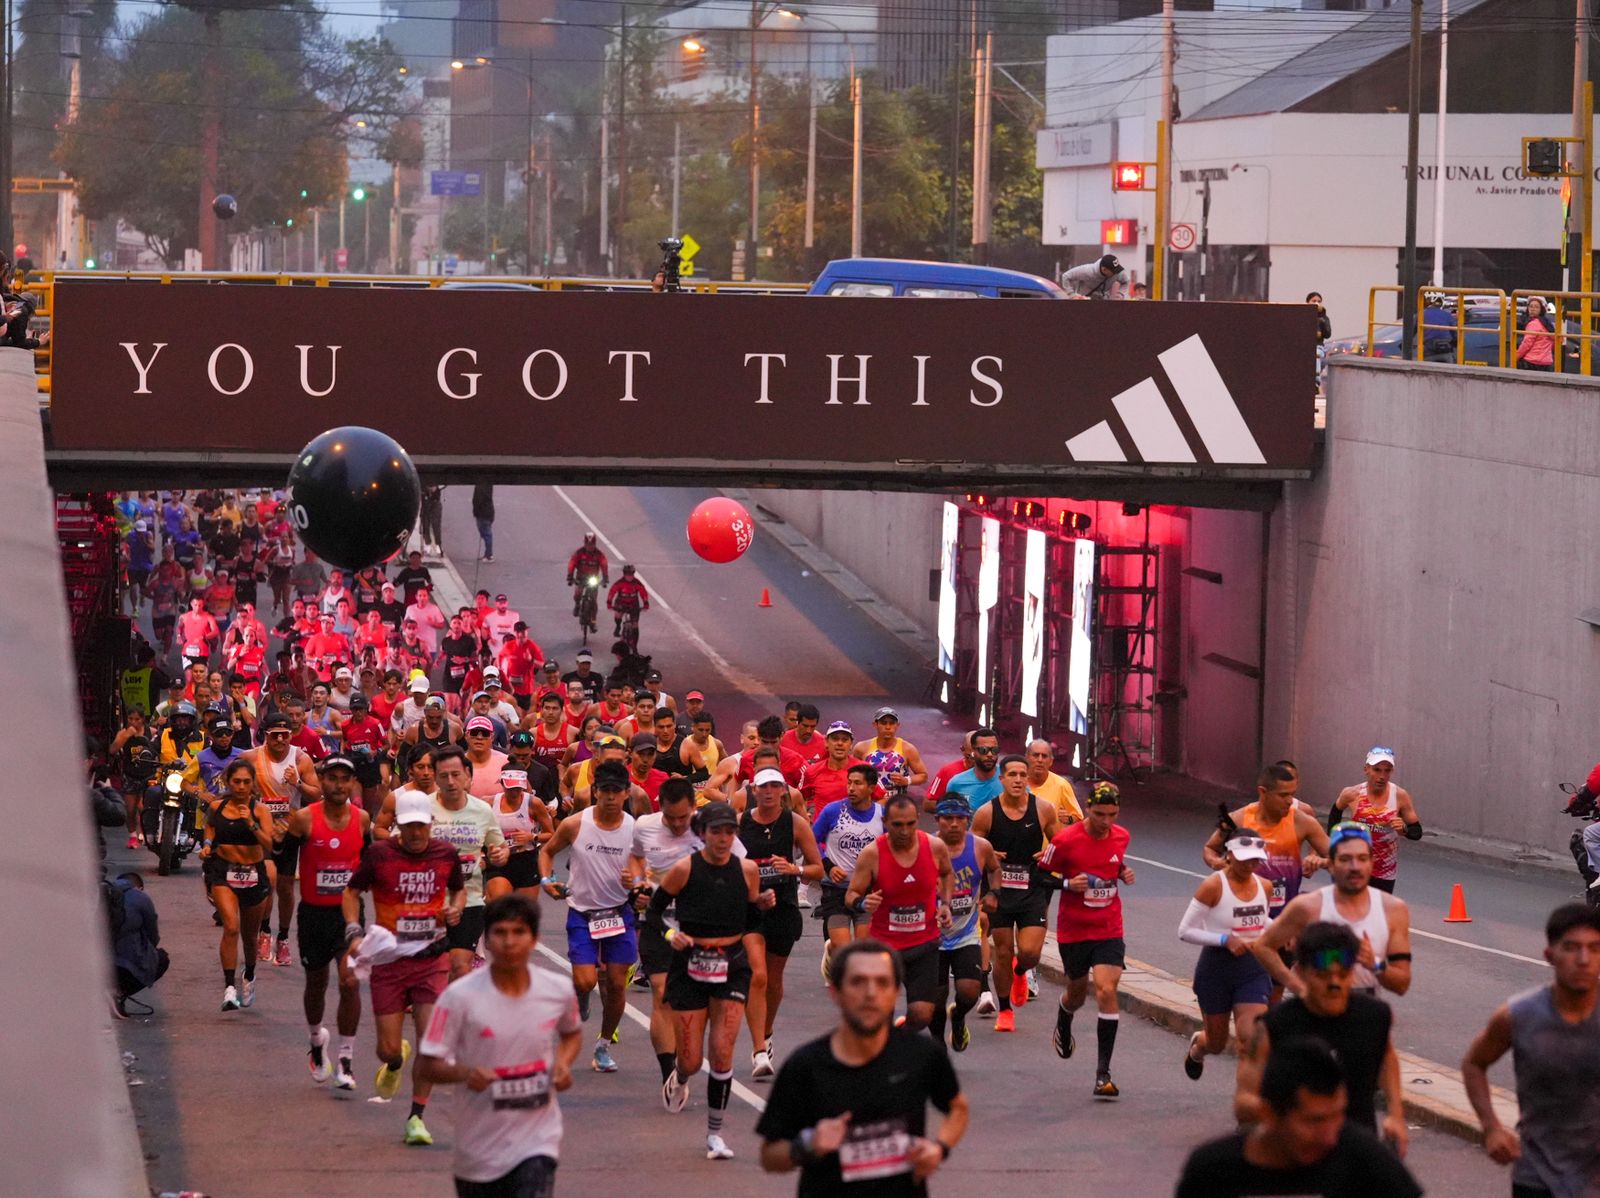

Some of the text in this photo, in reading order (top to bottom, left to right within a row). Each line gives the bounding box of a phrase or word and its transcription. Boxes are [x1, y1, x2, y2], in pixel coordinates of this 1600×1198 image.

[1475, 186, 1488, 194] Av.
[1490, 186, 1517, 195] Javier
[1520, 187, 1546, 195] Prado
[1175, 229, 1190, 242] 30
[119, 342, 1004, 407] YOU GOT THIS
[731, 519, 748, 553] 3:20
[233, 872, 251, 881] 407
[399, 869, 436, 884] PERÚ
[404, 893, 430, 904] LAB
[1093, 889, 1110, 898] 991
[894, 914, 920, 923] 4862
[1241, 916, 1260, 926] 530
[403, 921, 430, 930] 5738
[593, 919, 619, 930] 5078
